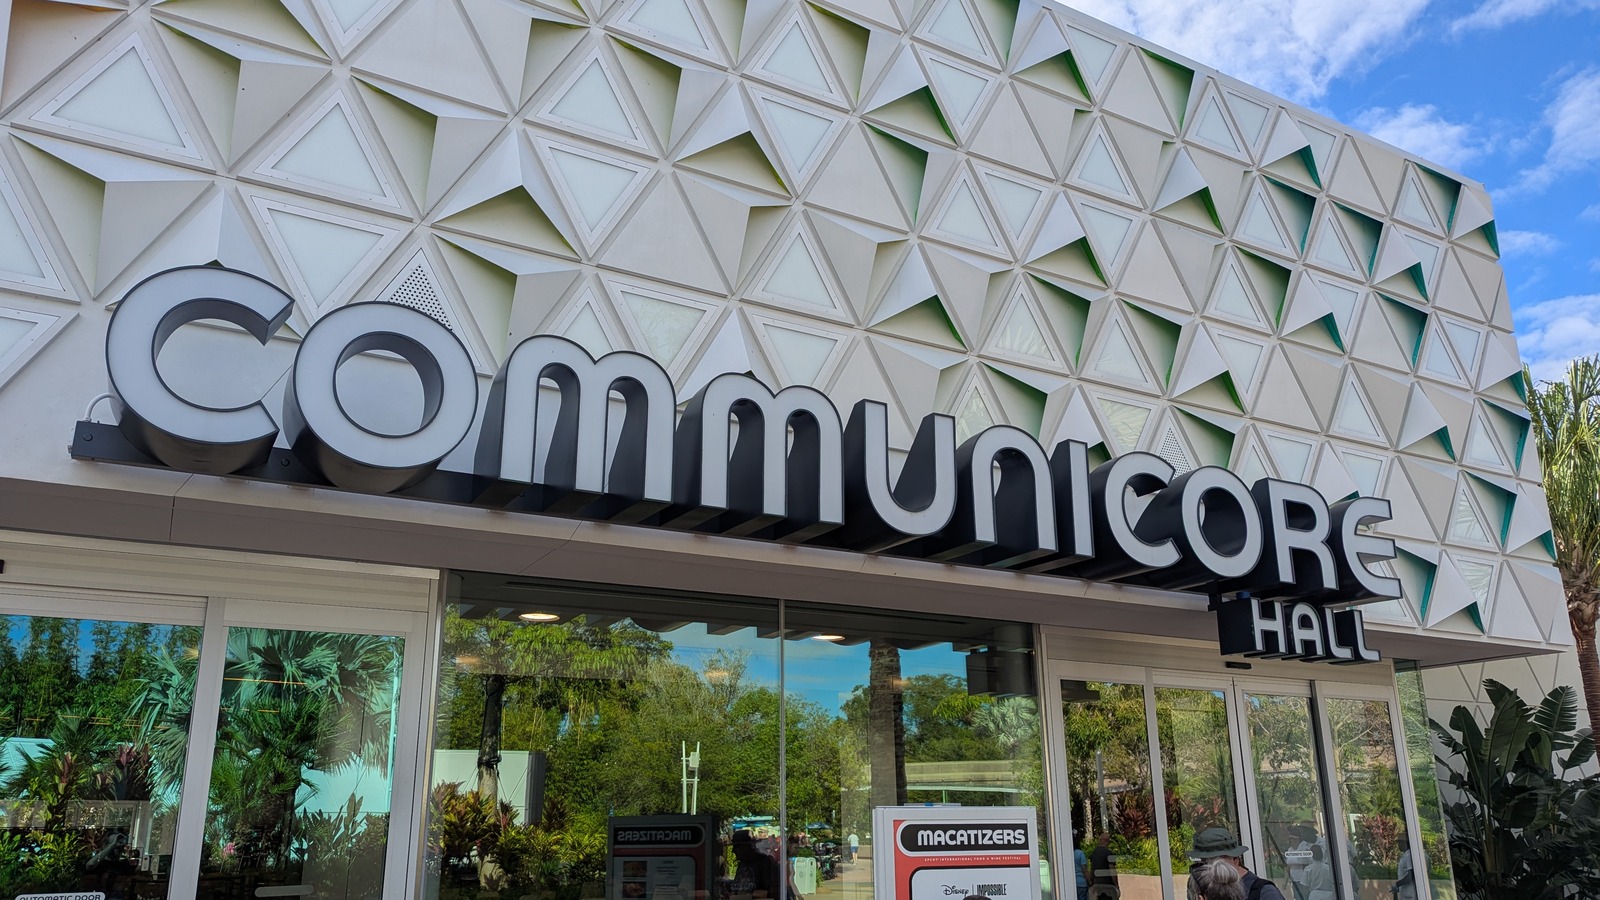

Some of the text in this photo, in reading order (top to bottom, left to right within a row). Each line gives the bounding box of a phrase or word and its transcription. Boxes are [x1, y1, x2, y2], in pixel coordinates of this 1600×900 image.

[105, 264, 1402, 600] COMMUNICORE
[1248, 597, 1382, 663] HALL
[917, 829, 1026, 846] MACATIZERS
